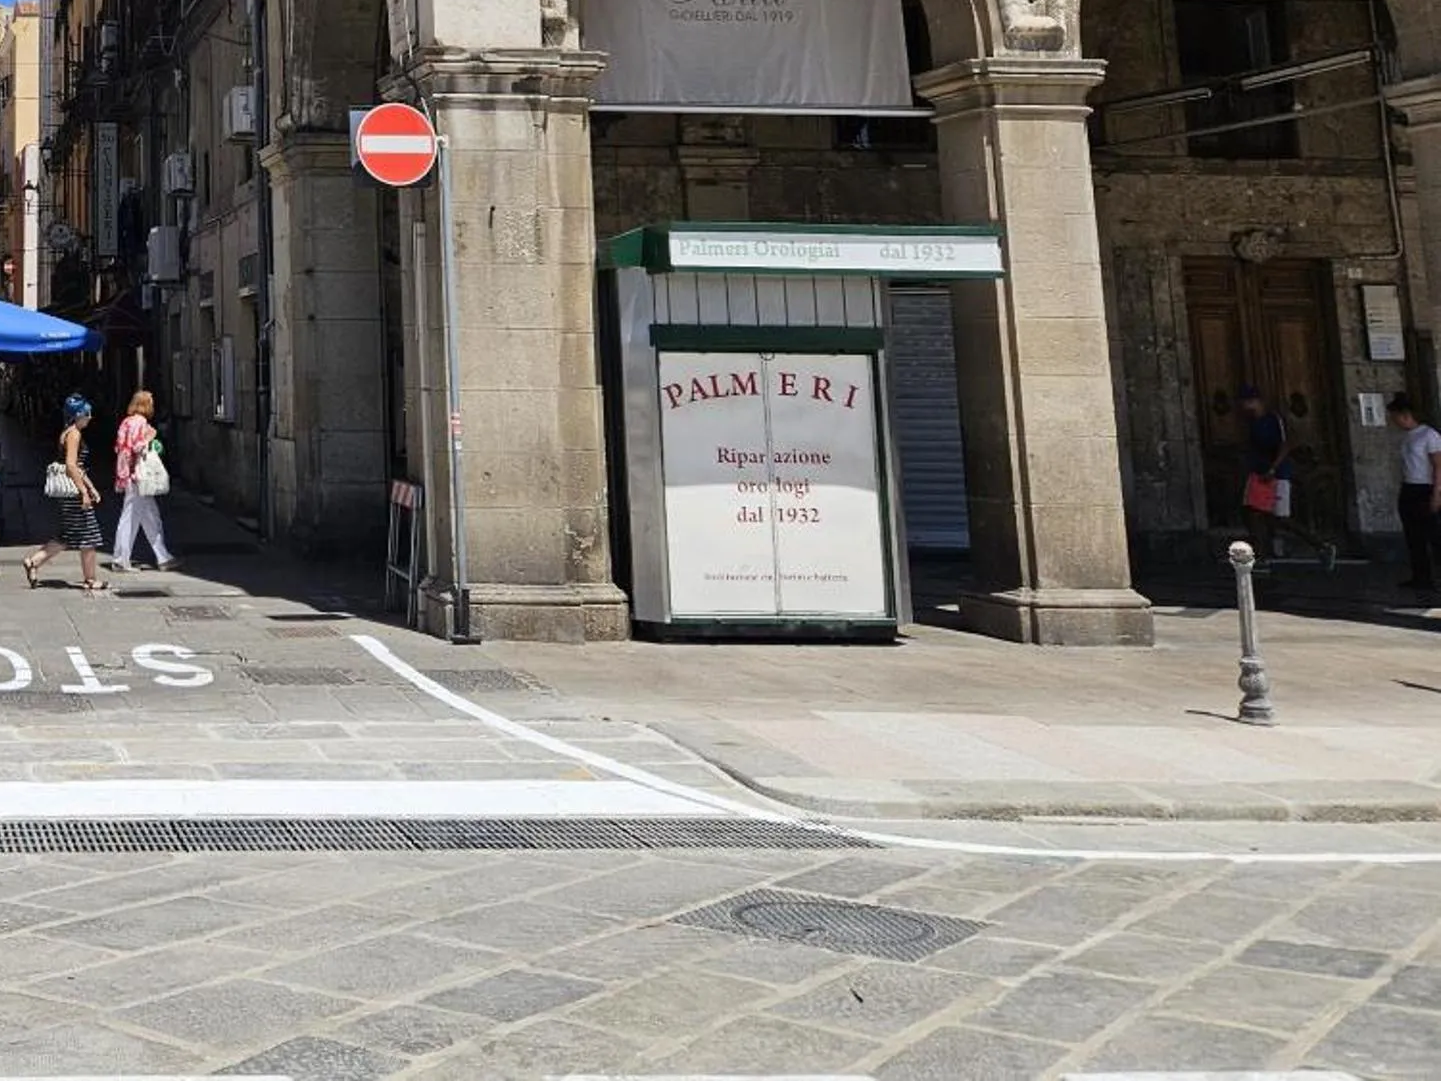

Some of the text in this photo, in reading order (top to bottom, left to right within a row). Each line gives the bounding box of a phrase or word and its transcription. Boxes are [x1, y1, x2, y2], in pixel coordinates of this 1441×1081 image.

[763, 11, 794, 23] 1919
[679, 239, 956, 261] Palmeri Orologiai dal 1932
[663, 372, 859, 409] PALMERI
[737, 506, 821, 523] dal 1932
